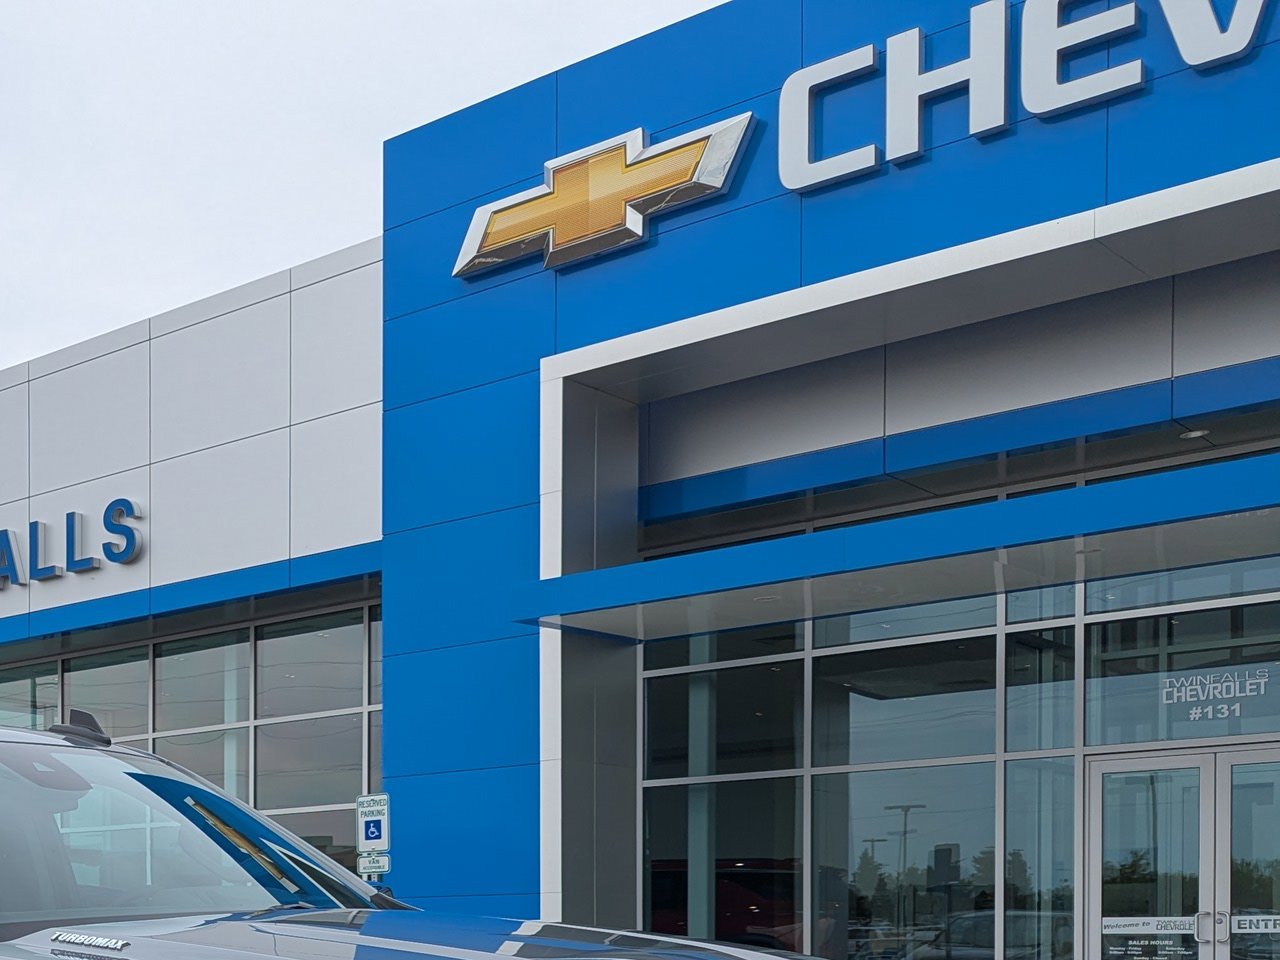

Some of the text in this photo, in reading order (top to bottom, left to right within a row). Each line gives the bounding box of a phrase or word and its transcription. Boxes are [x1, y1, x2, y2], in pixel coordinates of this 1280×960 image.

[1162, 669, 1269, 688] TWINFALLS
[1162, 679, 1269, 705] CHEVROLET
[1189, 703, 1241, 721] #131
[358, 799, 387, 808] RESERVED
[360, 809, 386, 818] PARKING
[1103, 922, 1140, 930] Welcome
[50, 931, 131, 951] TURBOMAX
